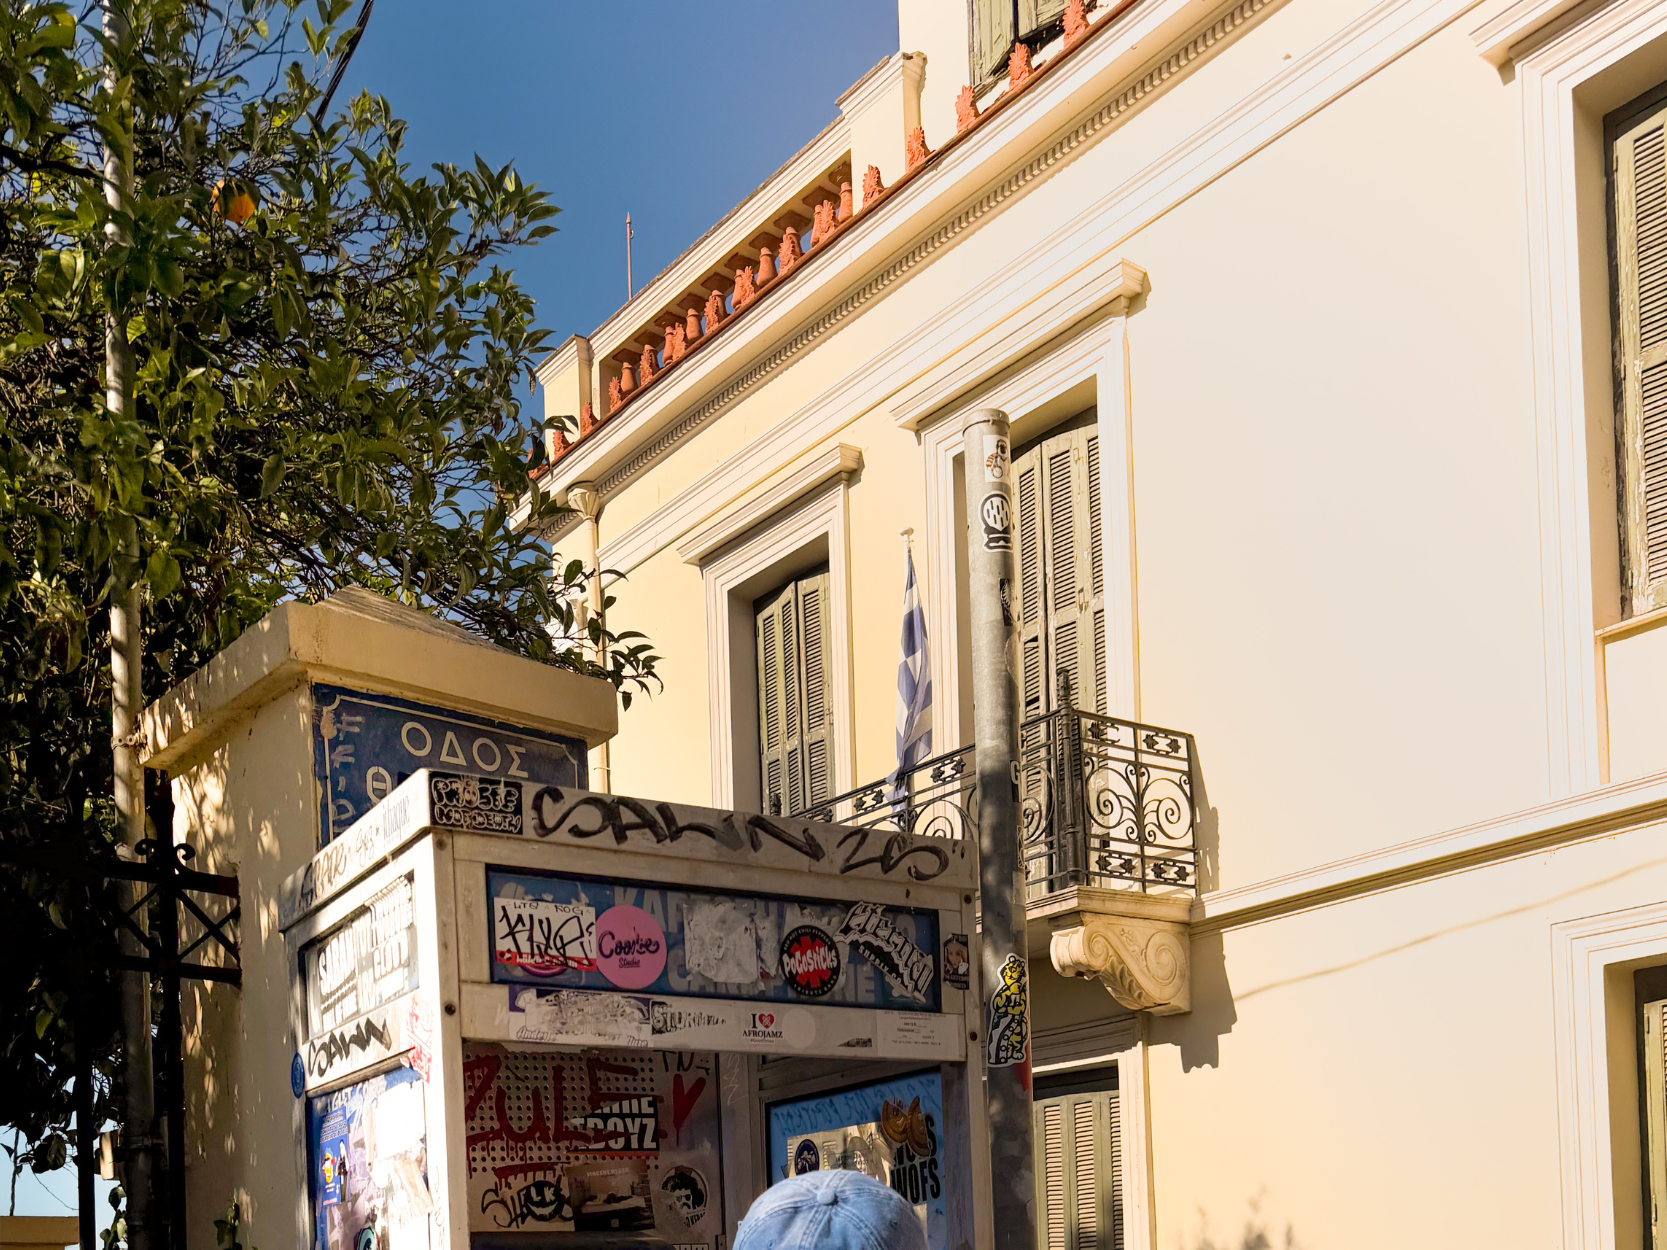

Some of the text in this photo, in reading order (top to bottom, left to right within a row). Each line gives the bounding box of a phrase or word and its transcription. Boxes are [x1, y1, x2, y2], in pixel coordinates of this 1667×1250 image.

[400, 721, 529, 779] ΟΔΟΣ
[751, 1013, 758, 1029] I
[742, 1030, 784, 1039] AFROJAMZ
